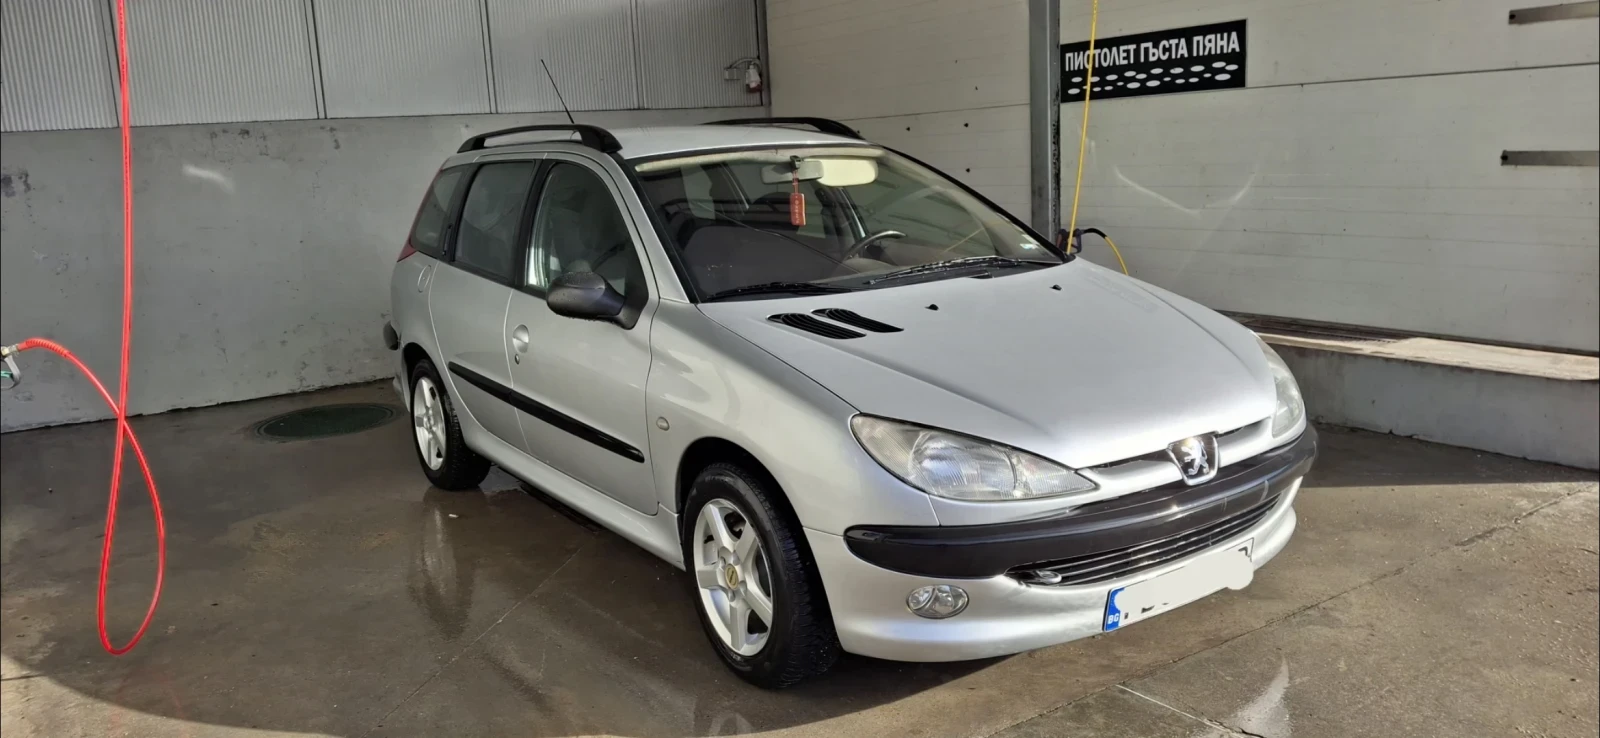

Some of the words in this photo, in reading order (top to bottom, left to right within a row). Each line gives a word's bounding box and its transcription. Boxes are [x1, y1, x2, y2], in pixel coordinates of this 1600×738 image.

[1065, 44, 1137, 72] ПИСТОЛЕТ
[1140, 37, 1188, 63] ГЪСТА
[1192, 31, 1240, 57] ПЯНА
[1107, 613, 1120, 625] BG
